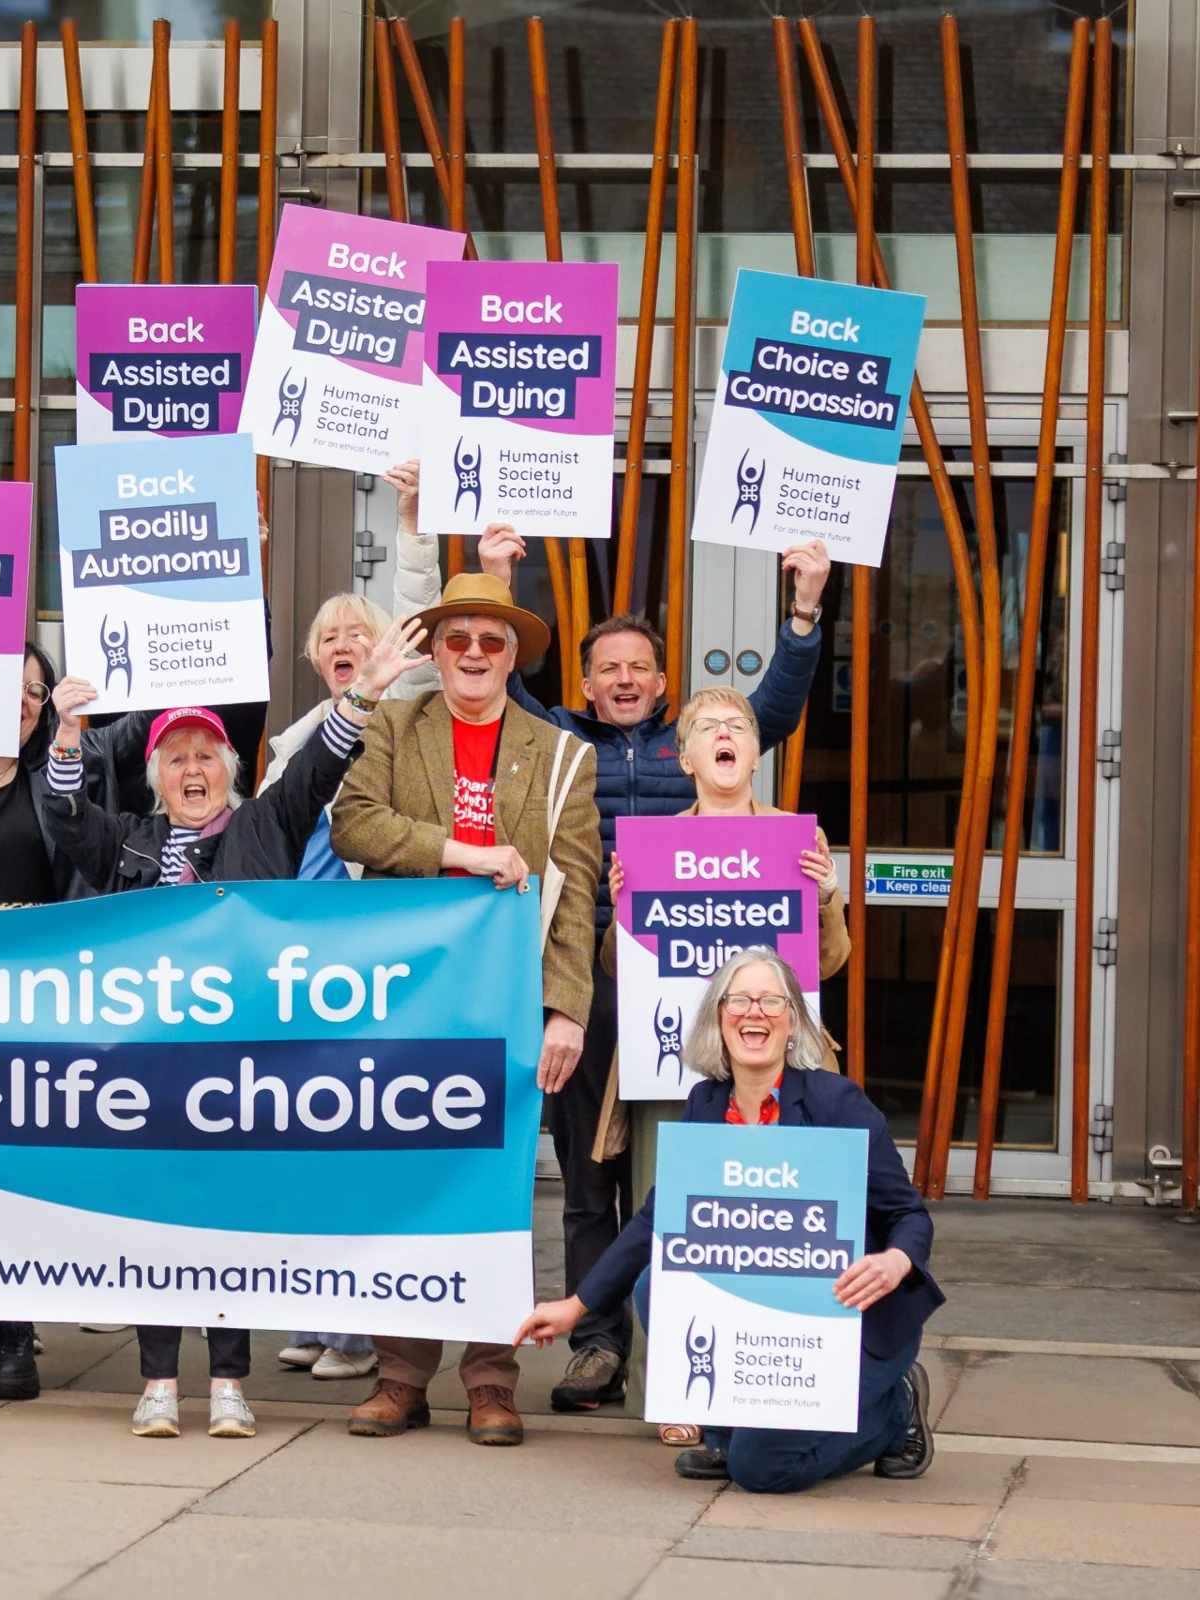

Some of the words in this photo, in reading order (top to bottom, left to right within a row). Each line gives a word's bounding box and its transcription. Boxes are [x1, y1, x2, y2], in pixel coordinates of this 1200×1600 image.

[327, 243, 407, 279] Back
[291, 280, 425, 325] Assisted
[481, 295, 563, 324] Back
[128, 316, 204, 343] Back
[790, 310, 860, 343] Back
[306, 319, 397, 363] Dying
[450, 340, 589, 370] Assisted
[757, 346, 849, 381] Choice
[857, 361, 878, 385] &
[101, 359, 229, 386] Assisted
[323, 385, 399, 409] Humanist
[473, 381, 565, 416] Dying
[730, 376, 894, 422] Compassion
[124, 397, 209, 429] Dying
[320, 401, 380, 424] Society
[317, 417, 389, 440] Scotland
[313, 438, 326, 446] For
[340, 443, 365, 453] ethical
[366, 447, 389, 457] future
[500, 450, 579, 464] Humanist
[117, 469, 195, 498] Back
[499, 468, 561, 484] Society
[782, 467, 861, 490] Humanist
[498, 485, 572, 499] Scotland
[779, 484, 840, 507] Society
[525, 508, 551, 516] ethical
[553, 509, 577, 517] future
[776, 502, 850, 524] Scotland
[109, 510, 207, 541] Bodily
[773, 525, 786, 533] For
[800, 529, 826, 539] ethical
[827, 532, 851, 542] future
[80, 548, 240, 580] Autonomy
[147, 618, 230, 636] Humanist
[148, 638, 213, 654] Society
[149, 653, 226, 671] Scotland
[179, 678, 206, 686] ethical
[209, 676, 233, 684] future
[675, 849, 761, 880] Back
[893, 866, 918, 877] Fire
[922, 868, 945, 878] exit
[886, 881, 917, 894] Keep
[645, 896, 789, 927] Assisted
[267, 944, 411, 1023] for
[185, 1056, 486, 1132] choice
[723, 1160, 799, 1189] Back
[692, 1202, 794, 1232] Choice
[803, 1206, 827, 1233] &
[666, 1237, 848, 1272] Compassion
[736, 1332, 823, 1349] Humanist
[734, 1351, 803, 1371] Society
[734, 1371, 816, 1388] Scotland
[733, 1396, 747, 1404] For
[763, 1397, 792, 1406] ethical
[794, 1399, 821, 1407] future
